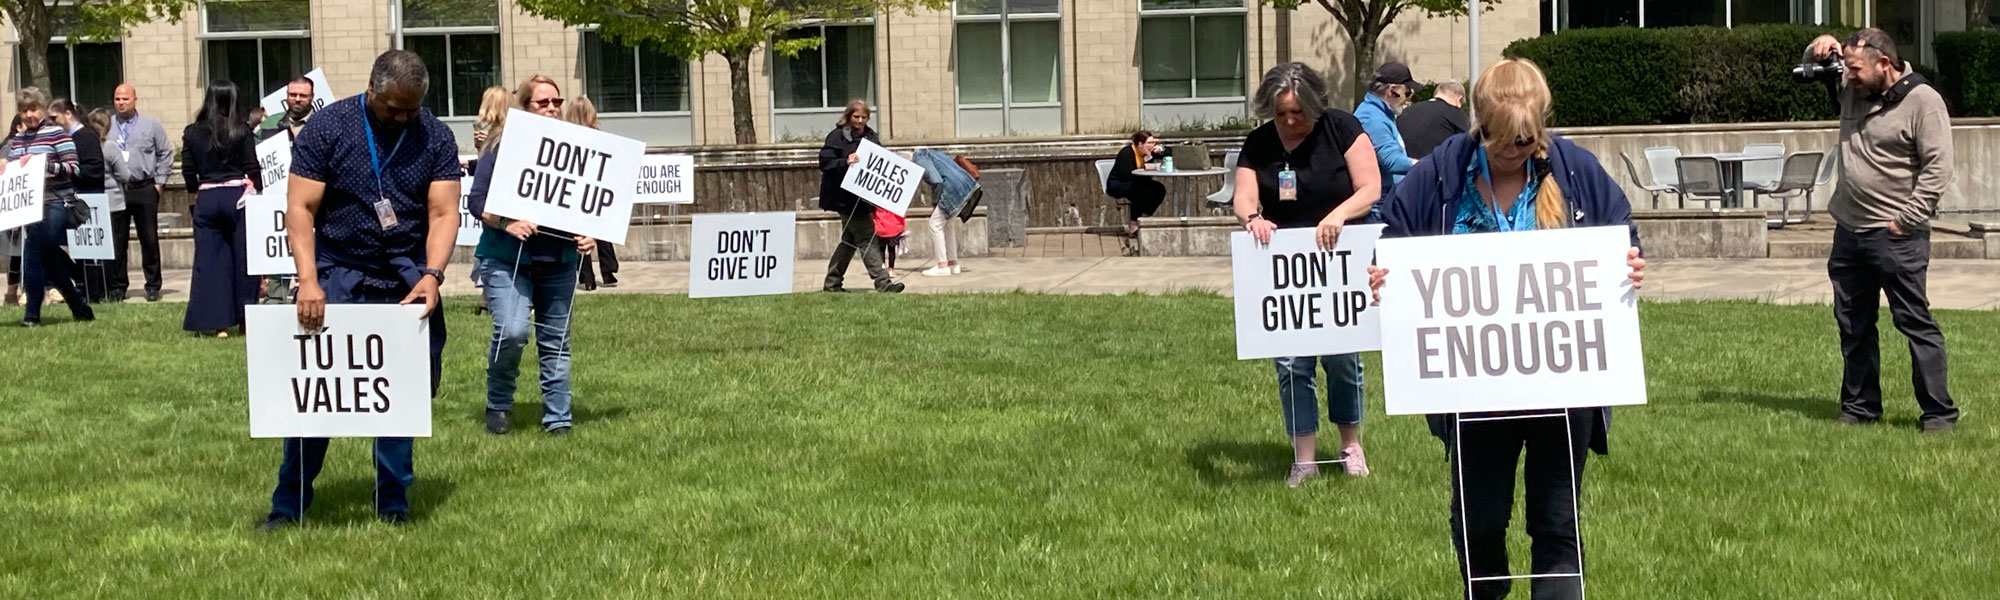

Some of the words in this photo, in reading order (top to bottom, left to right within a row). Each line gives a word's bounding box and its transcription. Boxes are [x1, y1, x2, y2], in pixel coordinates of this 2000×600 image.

[260, 150, 278, 171] ARE
[536, 137, 612, 182] DON'T
[660, 164, 681, 179] ARE
[866, 152, 909, 185] VALES
[7, 173, 29, 194] ARE
[262, 163, 286, 188] LONE
[636, 179, 682, 195] ENOUGH
[854, 168, 903, 204] MUCHO
[0, 189, 35, 213] ALONE
[517, 168, 576, 209] GIVE
[580, 183, 614, 217] UP
[75, 227, 93, 247] GIVE
[94, 227, 105, 247] UP
[266, 235, 294, 258] GIV
[717, 229, 771, 254] DON'T
[708, 256, 749, 281] GIVE
[754, 255, 777, 279] UP
[1272, 250, 1352, 290] DON'T
[1410, 265, 1499, 319] YOU
[1515, 259, 1603, 315] ARE
[1262, 293, 1324, 332] GIVE
[1332, 290, 1367, 327] UP
[293, 326, 334, 371] TÚ
[346, 333, 384, 371] LO
[1416, 318, 1608, 380] ENOUGH
[290, 376, 391, 414] VALES
